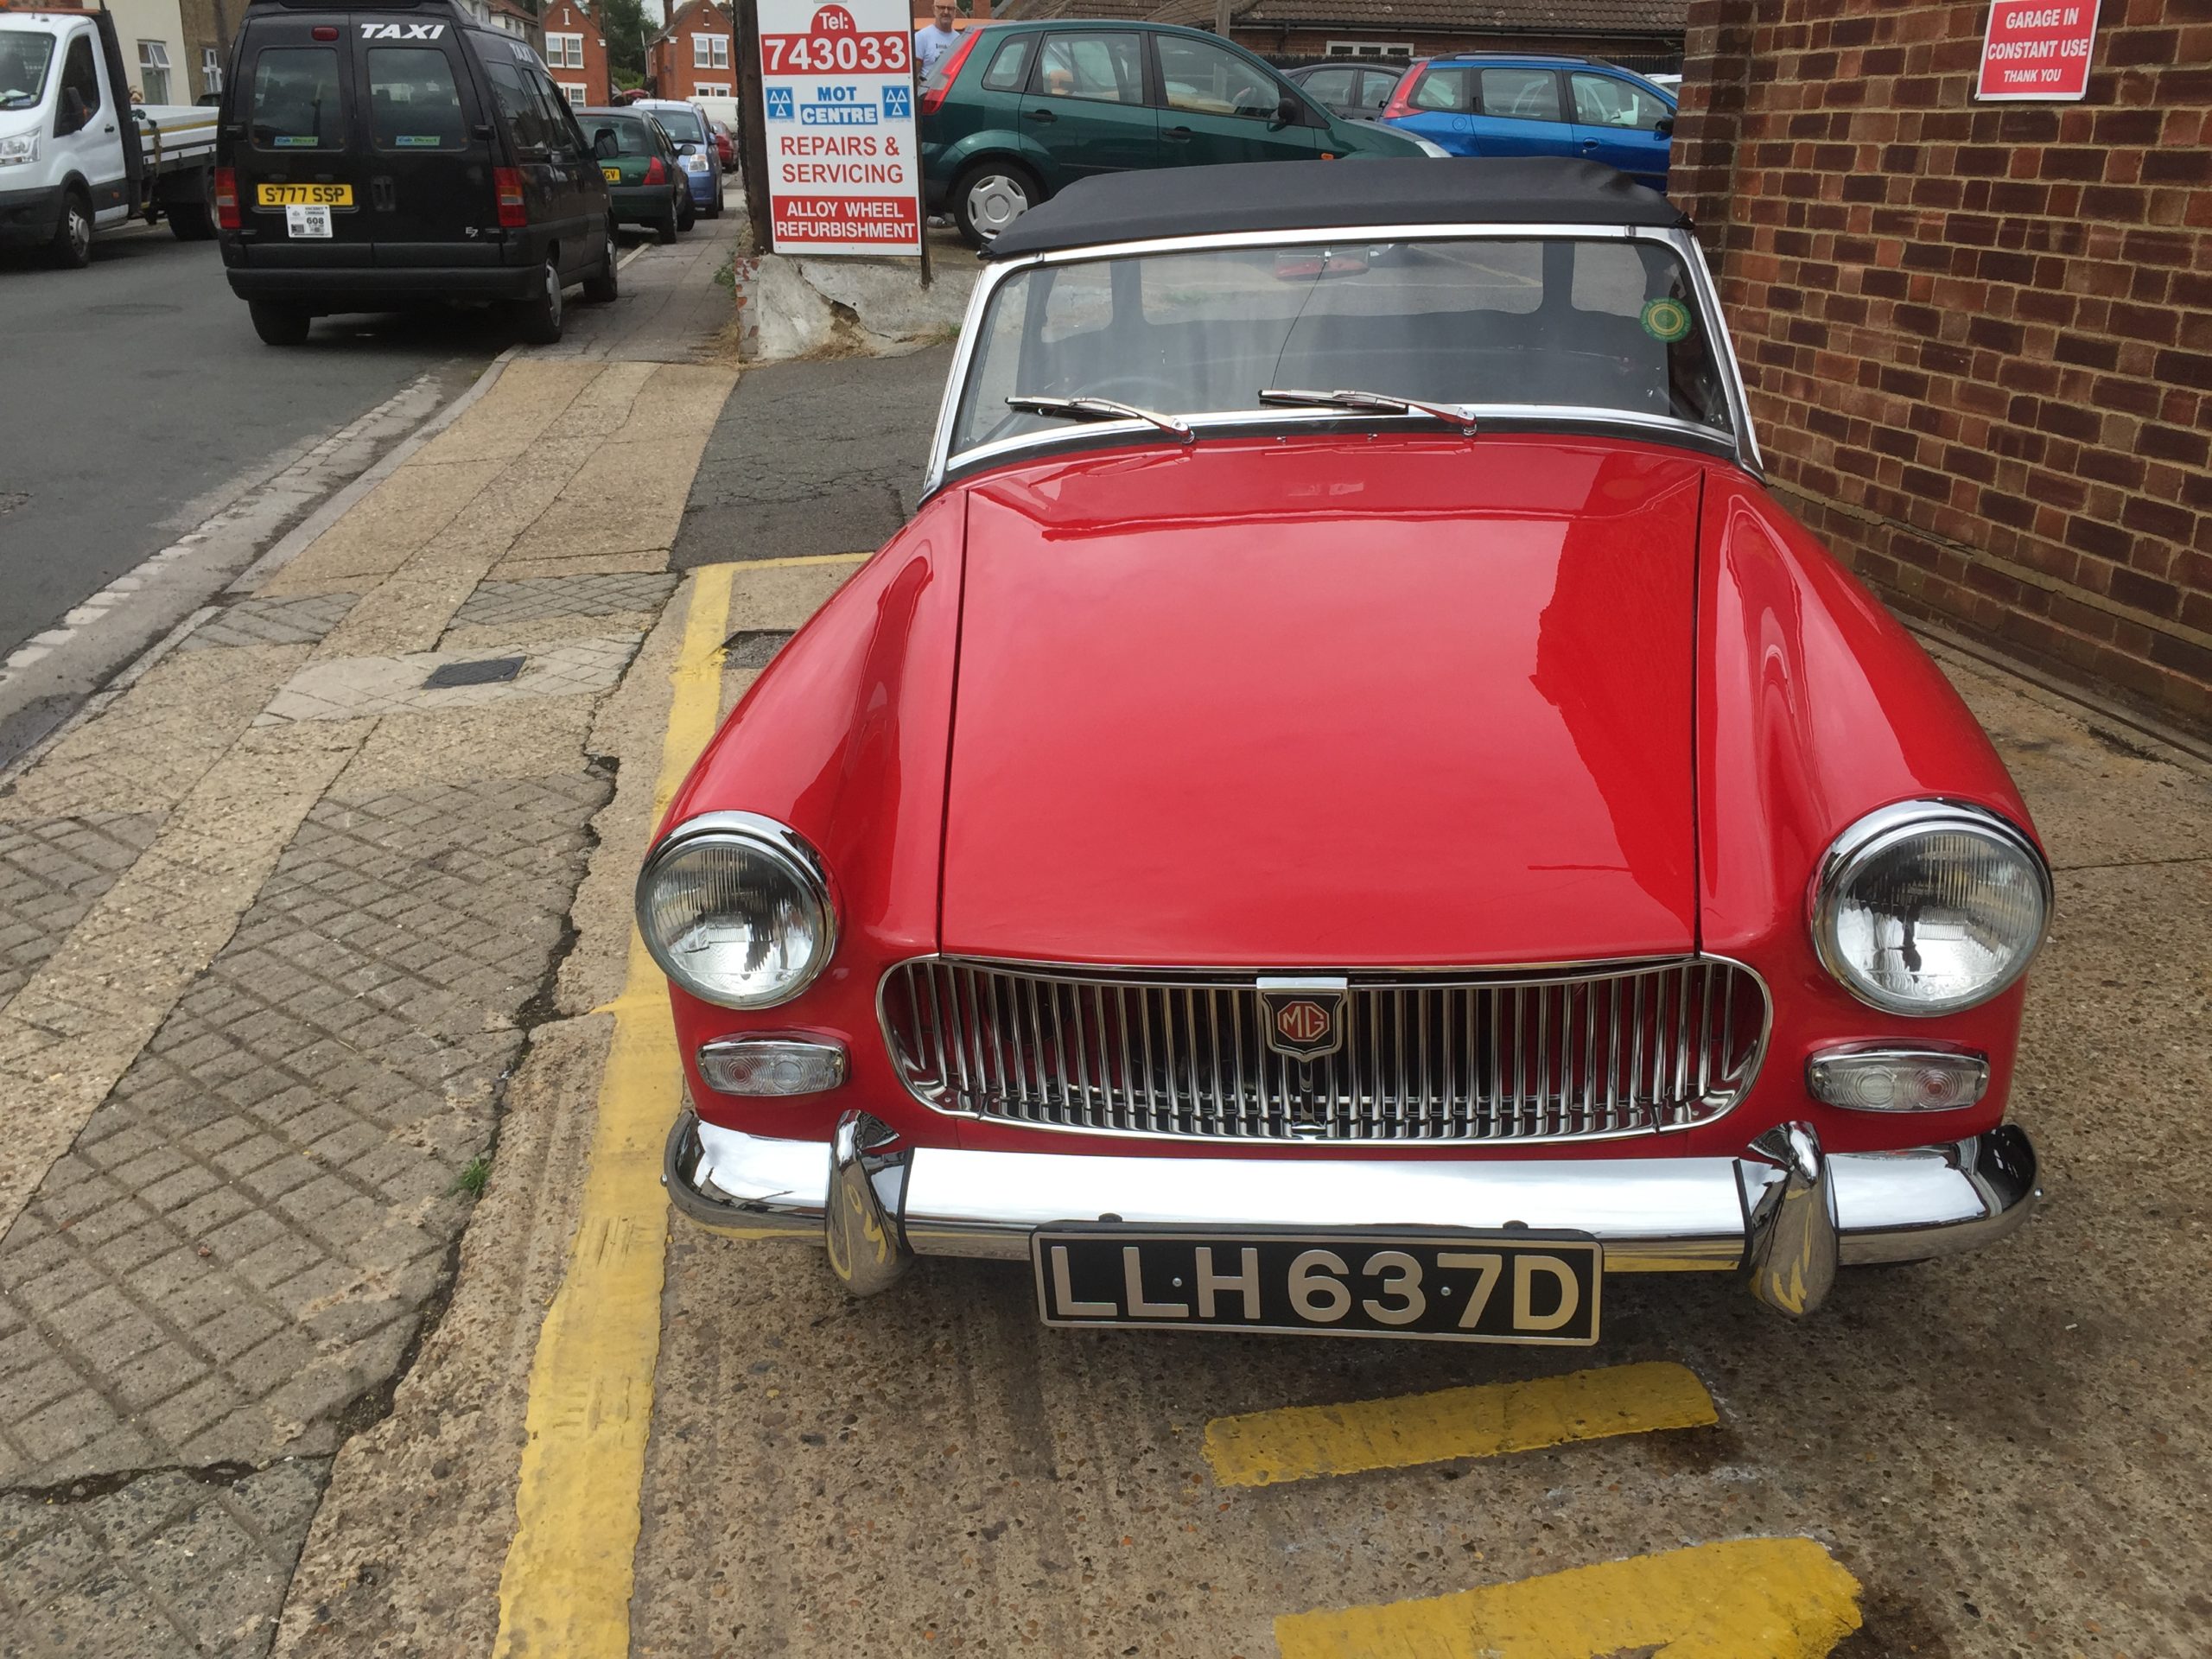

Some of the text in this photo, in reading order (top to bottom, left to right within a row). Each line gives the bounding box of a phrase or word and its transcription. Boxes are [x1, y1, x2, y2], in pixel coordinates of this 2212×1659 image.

[819, 12, 849, 30] Tel:
[2005, 7, 2080, 29] GARAGE IN
[360, 23, 445, 40] TAXI
[508, 42, 534, 63] TAXI
[765, 36, 906, 71] 743033
[1987, 38, 2089, 60] CONSTANT USE
[2004, 68, 2063, 83] THANK YOU
[817, 86, 857, 102] MOT
[802, 107, 877, 124] CENTRE
[780, 137, 900, 156] REPAIRS &
[782, 163, 904, 184] SERVICING
[264, 187, 345, 203] S777 SSP
[786, 201, 904, 218] ALLOY WHEEL
[776, 221, 916, 238] REFURBISHMENT
[1282, 1005, 1325, 1038] MG
[1050, 1246, 1580, 1332] LLH 637D
